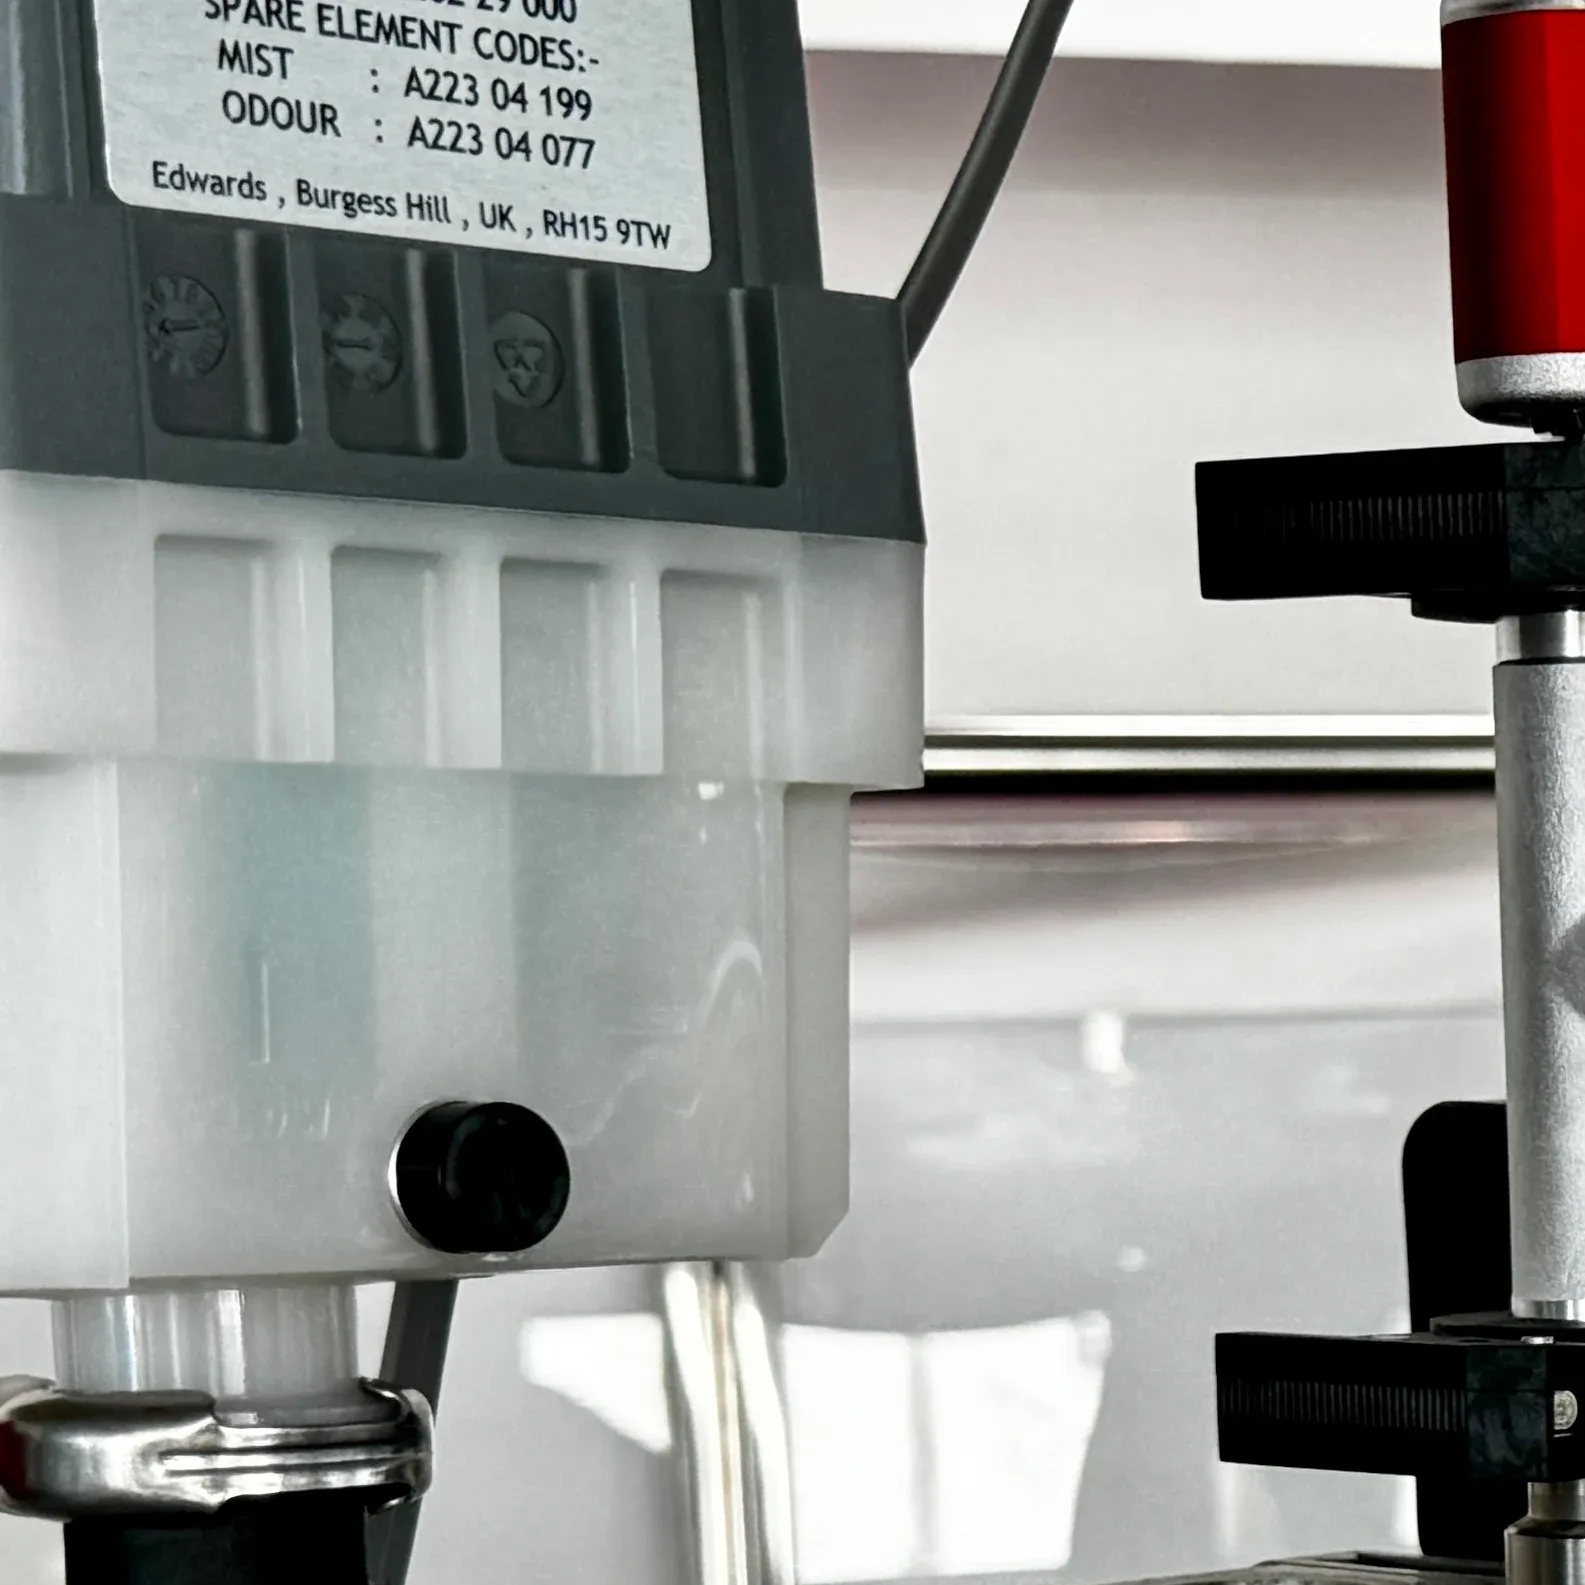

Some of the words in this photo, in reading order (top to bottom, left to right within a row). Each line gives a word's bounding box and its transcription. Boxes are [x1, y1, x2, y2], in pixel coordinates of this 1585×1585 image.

[205, 0, 306, 33] SPARE
[317, 3, 463, 54] ELEMENT
[473, 27, 599, 72] CODES:-
[218, 38, 294, 80] MIST
[404, 66, 479, 107] A223
[491, 78, 529, 114] 04
[539, 85, 592, 121] 199
[222, 90, 341, 137] ODOUR
[408, 115, 483, 156] A223
[495, 127, 532, 162] 04
[542, 133, 595, 169] 077
[152, 160, 267, 201] Edwards
[296, 178, 398, 218] Burgess
[406, 192, 451, 224] Hill
[479, 201, 517, 232] UK
[543, 209, 608, 242] RH15
[616, 218, 671, 250] 9TW
